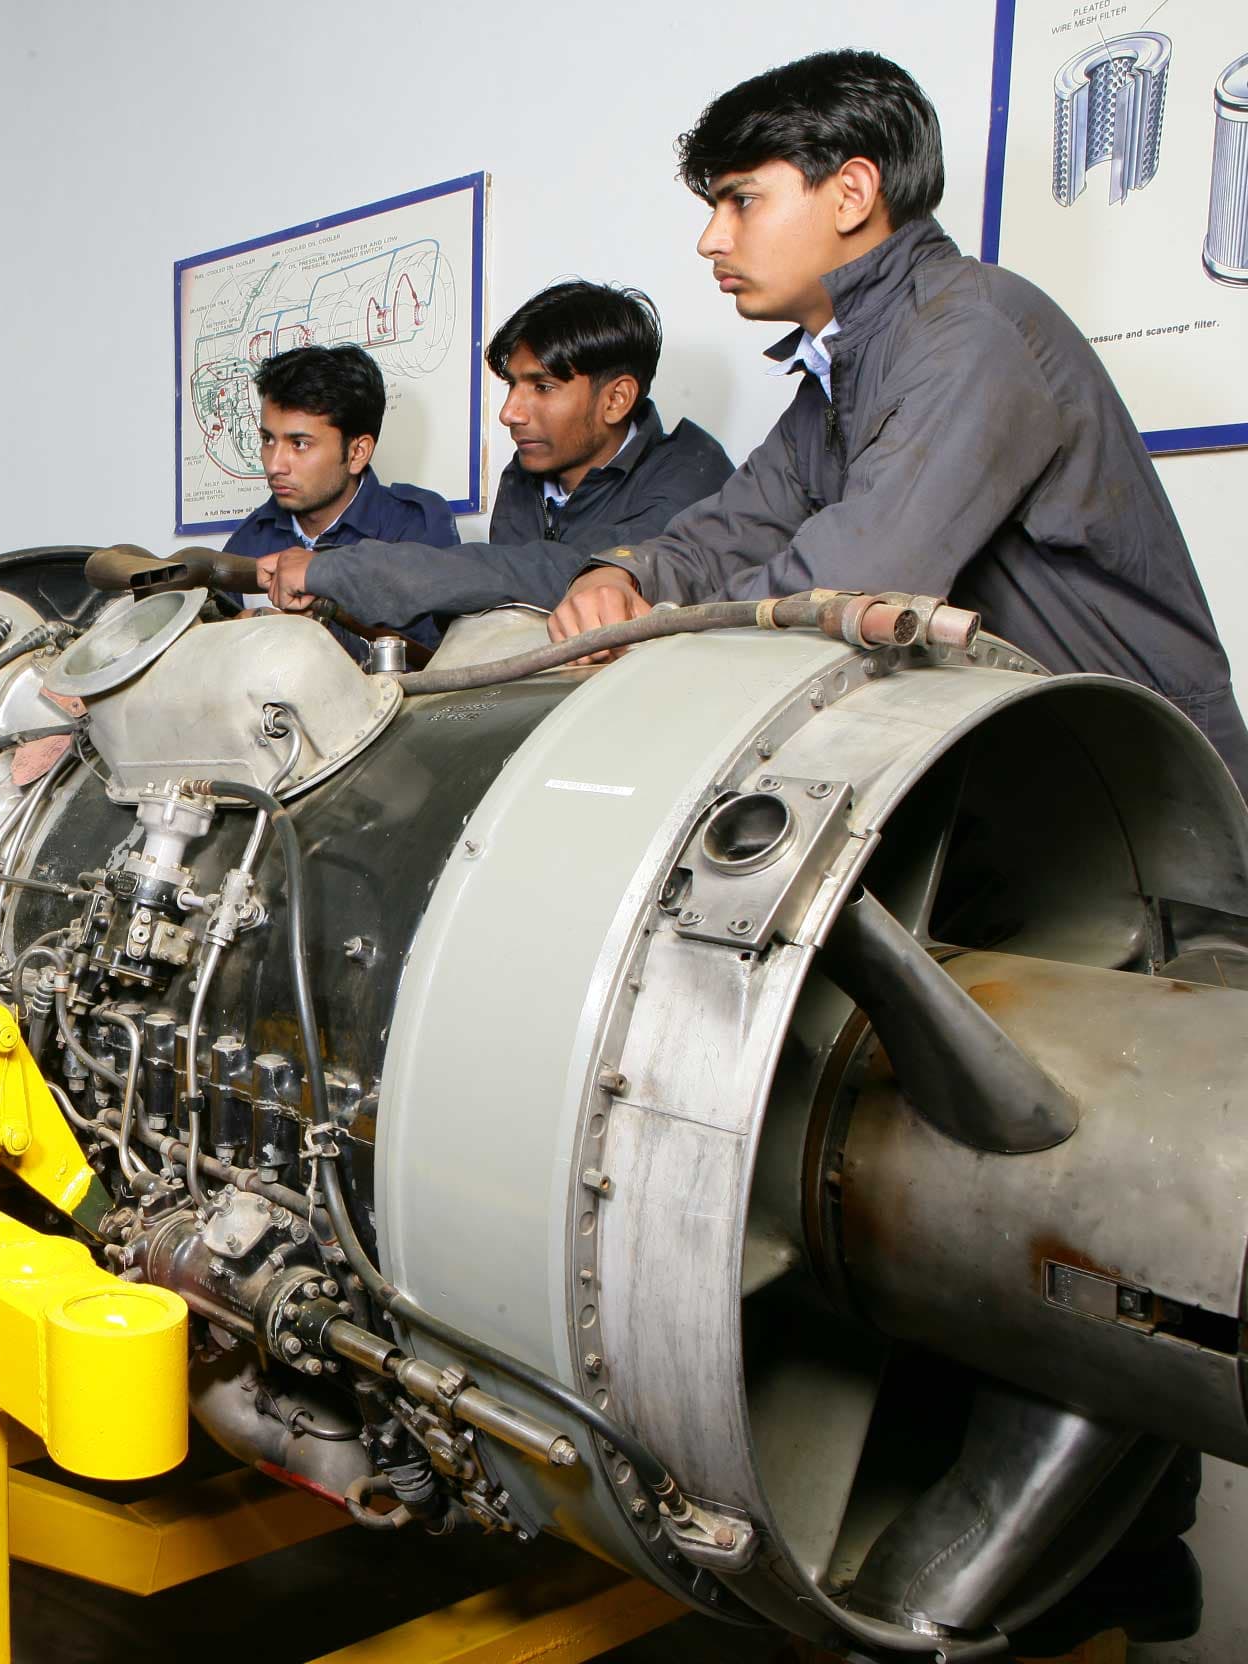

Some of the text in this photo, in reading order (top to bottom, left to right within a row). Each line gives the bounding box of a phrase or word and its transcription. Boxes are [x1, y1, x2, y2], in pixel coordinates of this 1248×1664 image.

[1073, 0, 1110, 16] PLEATED
[1052, 6, 1127, 35] WIRE MESH FILTER
[1125, 329, 1143, 339] and
[1145, 323, 1190, 336] scavenge
[1193, 319, 1220, 330] filter.
